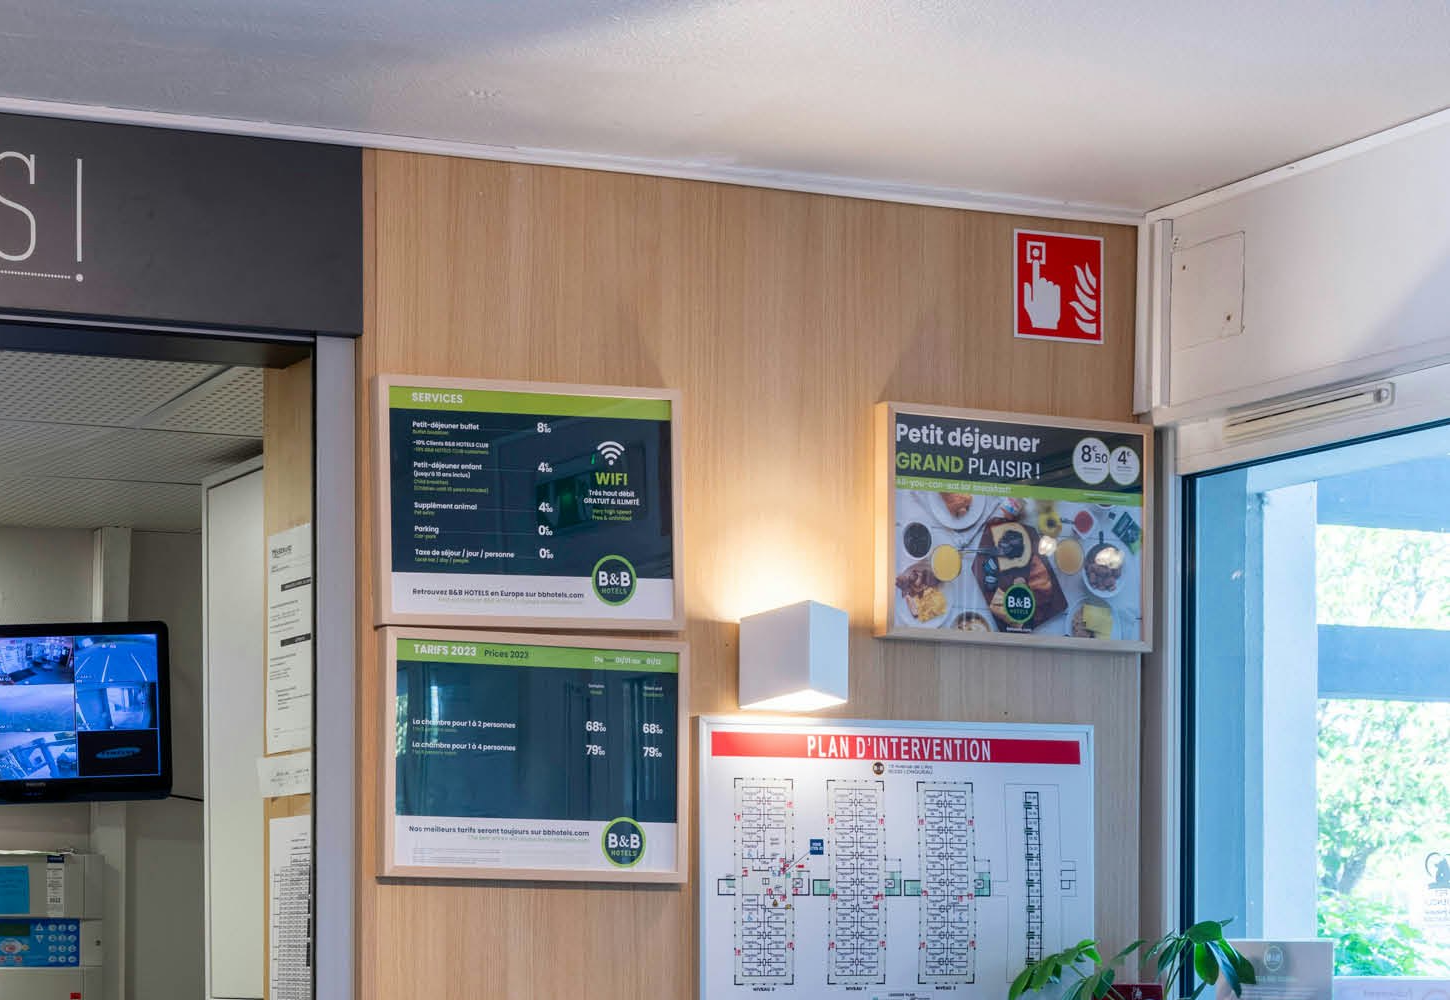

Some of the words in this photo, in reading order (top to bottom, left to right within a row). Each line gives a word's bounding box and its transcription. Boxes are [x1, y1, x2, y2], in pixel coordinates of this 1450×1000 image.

[412, 392, 463, 404] SERVICES
[412, 421, 458, 430] Petit-déjeuner
[460, 422, 479, 430] buffet
[896, 423, 944, 445] Petit
[948, 426, 1040, 454] déjeuner
[414, 462, 460, 470] Petit-déjeuner
[896, 452, 964, 473] GRAND
[968, 458, 1032, 479] PLAISIR
[595, 472, 628, 485] WIFI
[414, 502, 453, 511] Supplément
[414, 526, 439, 534] Parking
[466, 550, 479, 558] jour
[598, 571, 631, 587] B&B
[412, 588, 447, 596] Retrouvez
[501, 590, 524, 599] Europe
[538, 591, 584, 599] bbhotels.com
[601, 587, 627, 595] HOTELS
[1008, 596, 1032, 608] B&B
[414, 644, 448, 656] TARIFS
[451, 646, 476, 656] 2023
[484, 649, 509, 659] Prices
[510, 651, 529, 659] 2023
[807, 735, 849, 759] PLAN
[856, 736, 991, 761] D'INTERVENTION
[501, 828, 529, 836] toujours
[543, 829, 590, 837] bbhotels.com
[608, 834, 641, 849] B&B
